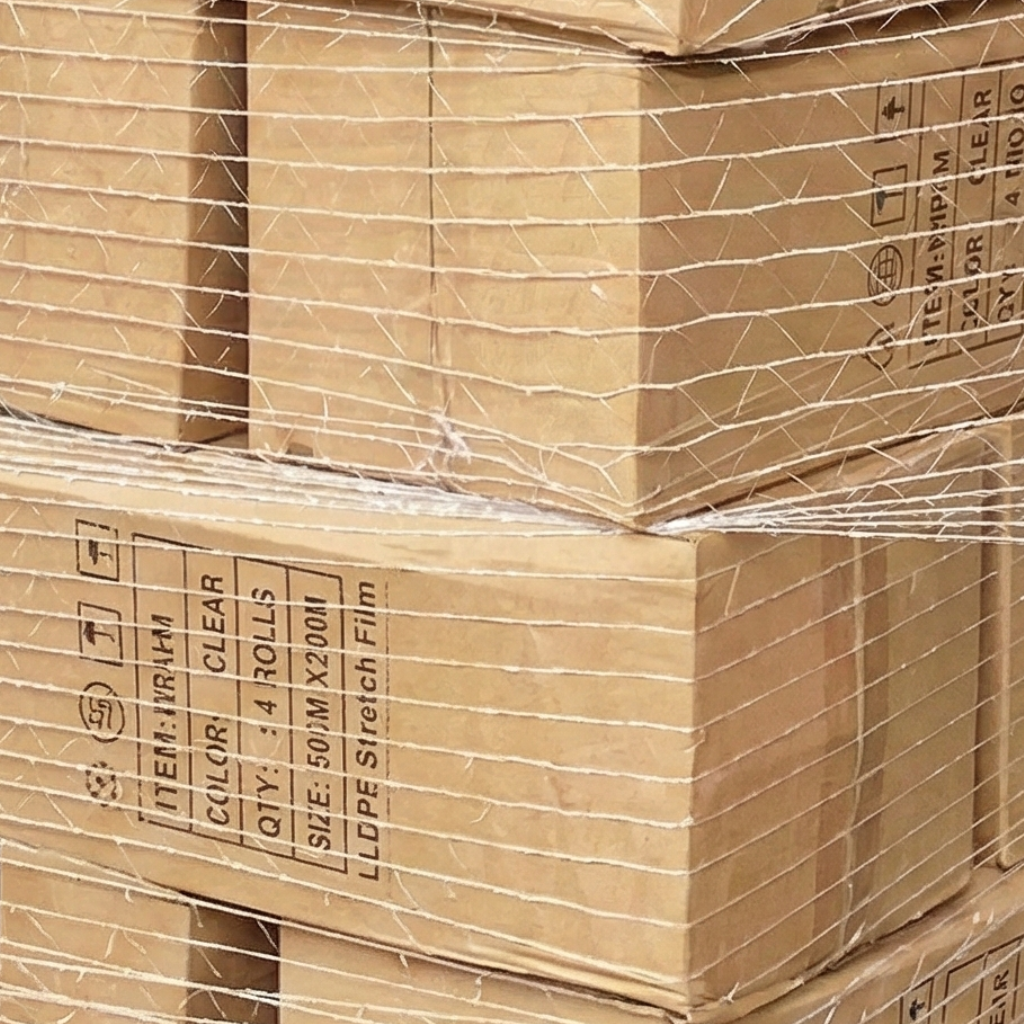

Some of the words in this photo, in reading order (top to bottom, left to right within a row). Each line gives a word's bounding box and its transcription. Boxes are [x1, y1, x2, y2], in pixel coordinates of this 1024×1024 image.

[968, 89, 992, 185] CLEAR
[201, 574, 227, 673] CLEAR
[251, 588, 278, 688] ROLLS
[354, 582, 377, 646] Film
[254, 699, 277, 715] 4
[355, 658, 377, 769] Stretch
[306, 782, 331, 851] SIZE:
[356, 779, 379, 881] LLDPE
